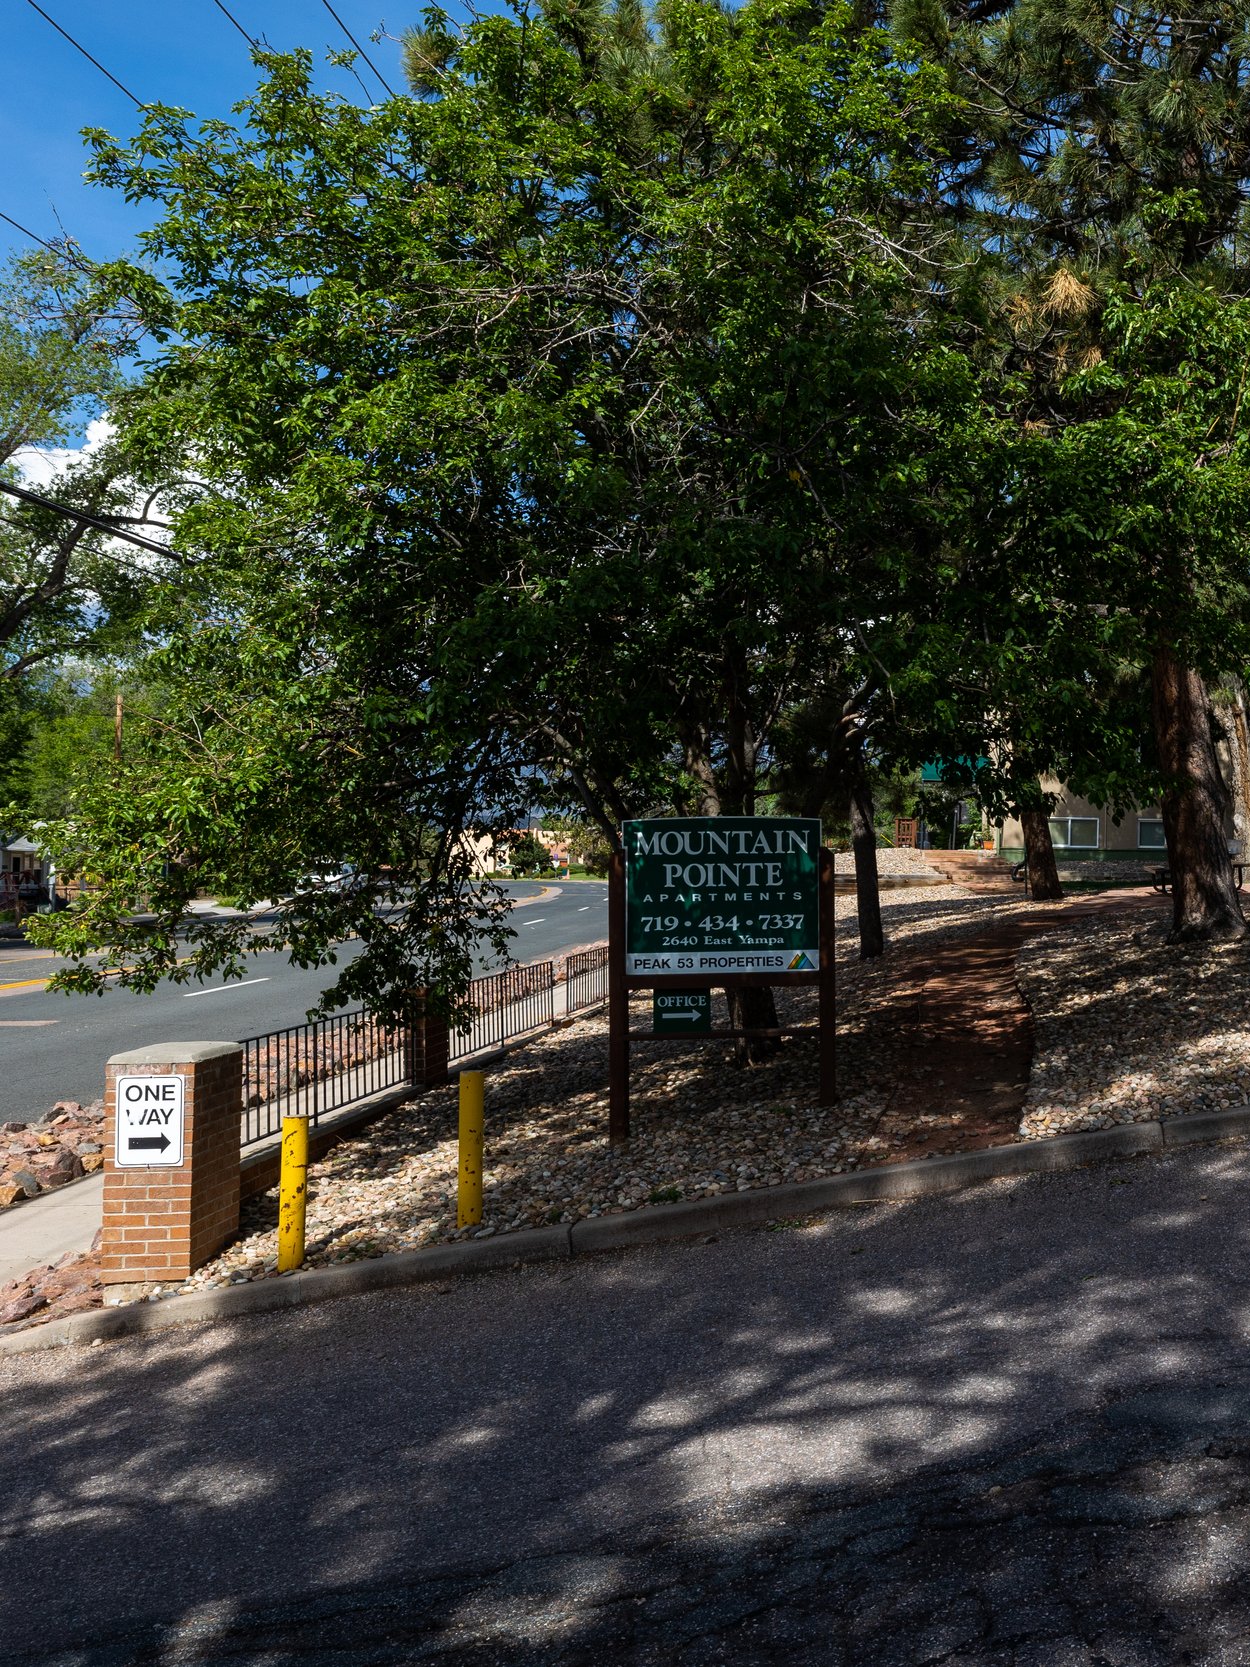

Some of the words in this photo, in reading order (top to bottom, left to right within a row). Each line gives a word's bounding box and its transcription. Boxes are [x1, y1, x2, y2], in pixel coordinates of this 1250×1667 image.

[633, 830, 810, 857] MOUNTAIN
[662, 862, 784, 888] POINTE
[643, 891, 803, 903] APARTMENTS
[641, 915, 679, 932] 719
[698, 915, 740, 932] 434
[758, 914, 805, 930] 7337
[662, 936, 698, 946] 2640
[703, 936, 732, 945] East
[739, 935, 784, 946] Yampa
[634, 958, 671, 969] PEAK
[677, 958, 694, 968] 53
[699, 956, 784, 968] PROPERTIES
[657, 995, 707, 1007] OFFICE
[125, 1084, 175, 1102] ONE
